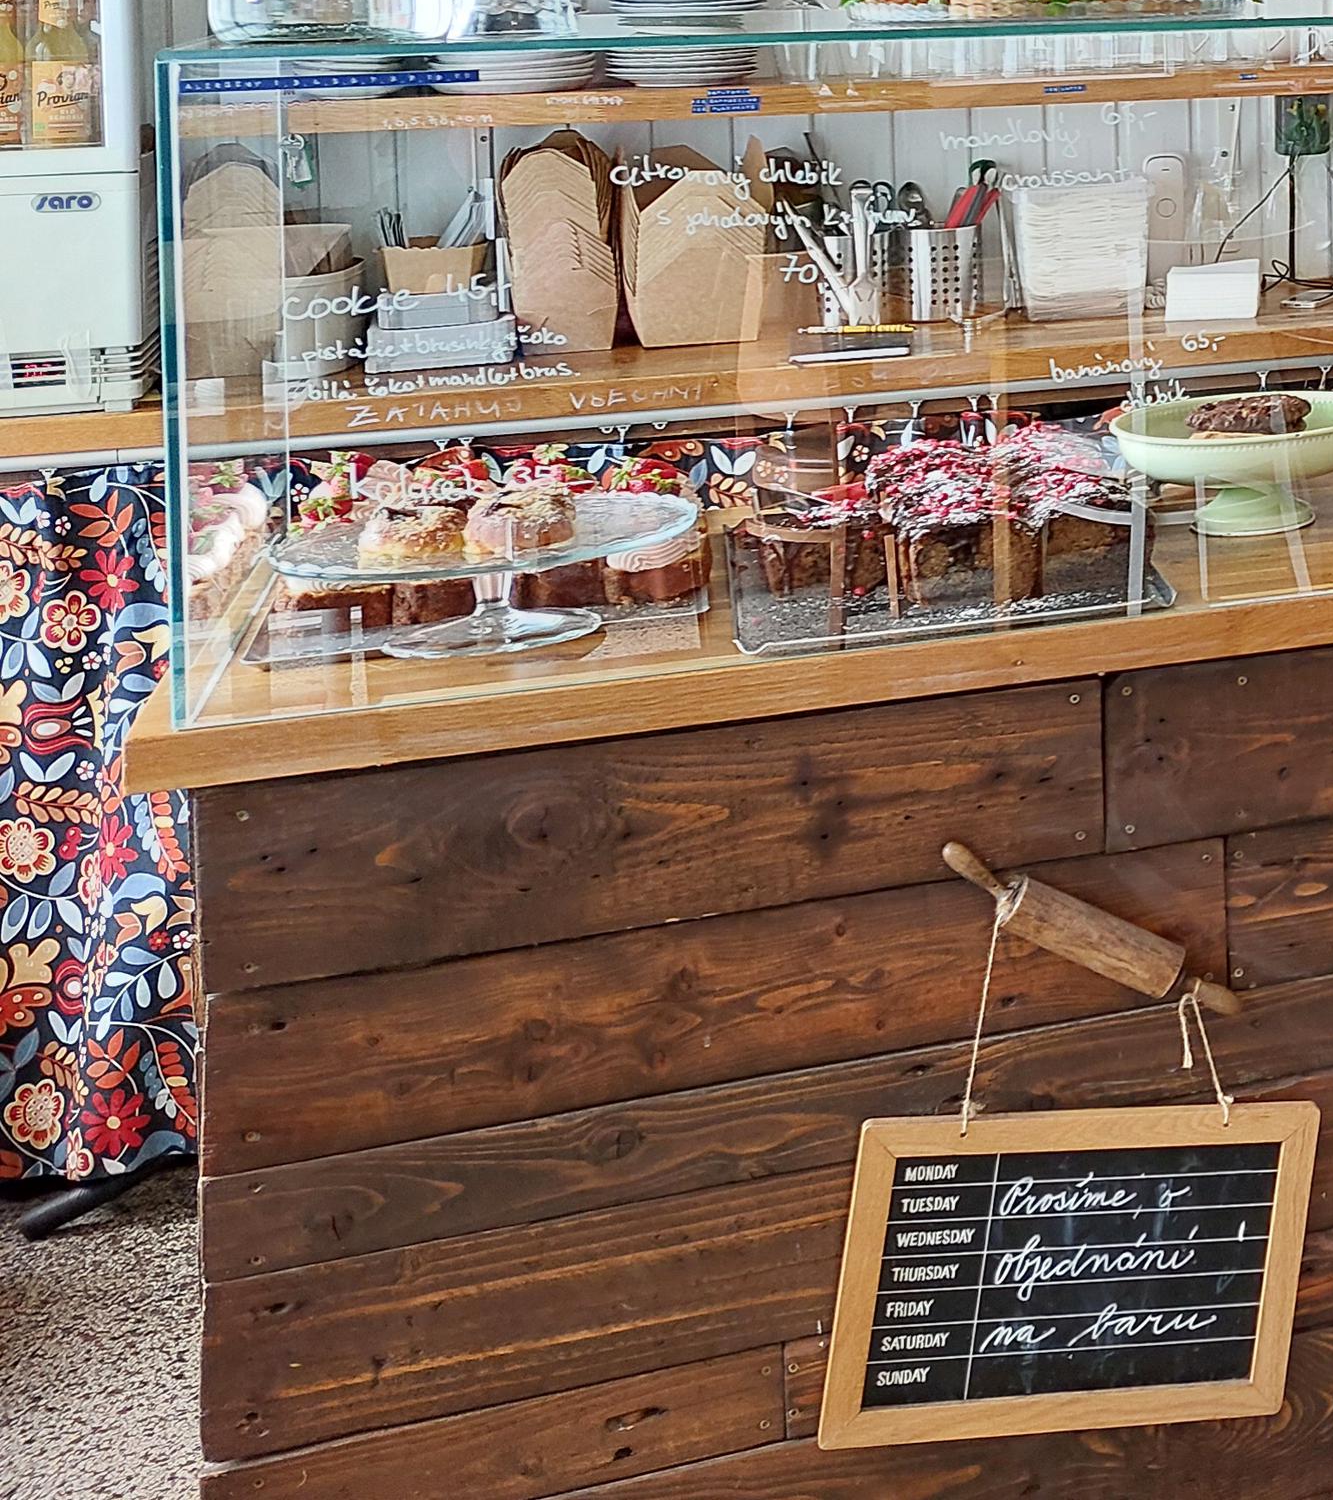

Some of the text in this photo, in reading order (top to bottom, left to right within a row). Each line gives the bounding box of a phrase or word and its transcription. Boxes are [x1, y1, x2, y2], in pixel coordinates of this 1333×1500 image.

[36, 194, 94, 212] saro
[281, 286, 421, 321] cookie
[1049, 341, 1163, 383] banánový
[904, 1163, 959, 1182] MONDAY
[901, 1195, 960, 1214] TUESDAY
[896, 1228, 975, 1248] WEDNESDAY
[891, 1225, 1198, 1301] THURSDAY objednání
[886, 1299, 934, 1319] FRIDAY
[881, 1302, 1218, 1353] SATURDAY na baru
[876, 1366, 930, 1386] SUNDAY
